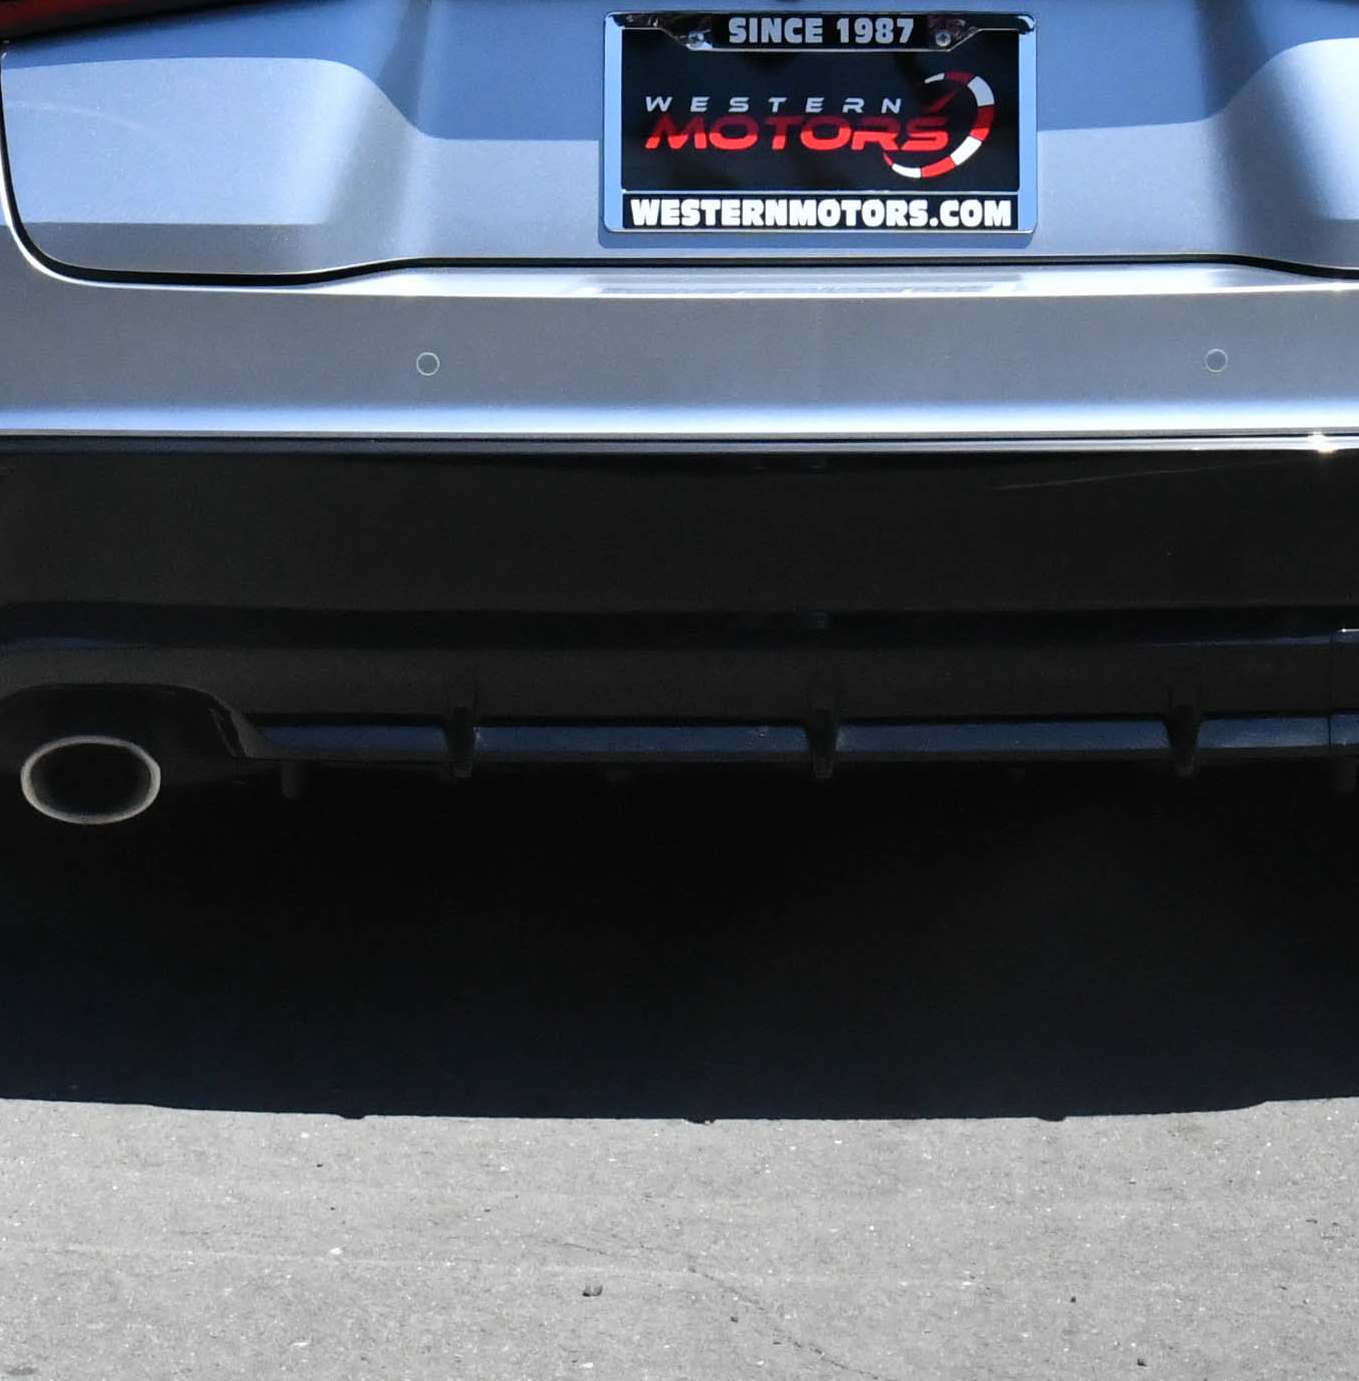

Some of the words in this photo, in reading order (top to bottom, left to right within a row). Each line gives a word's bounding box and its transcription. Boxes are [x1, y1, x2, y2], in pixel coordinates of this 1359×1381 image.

[728, 17, 823, 44] SINCE
[835, 17, 915, 44] 1987
[645, 96, 902, 114] WESTERN
[644, 115, 949, 151] MOTORS
[630, 197, 1012, 229] WESTERNMOTORS.COM
